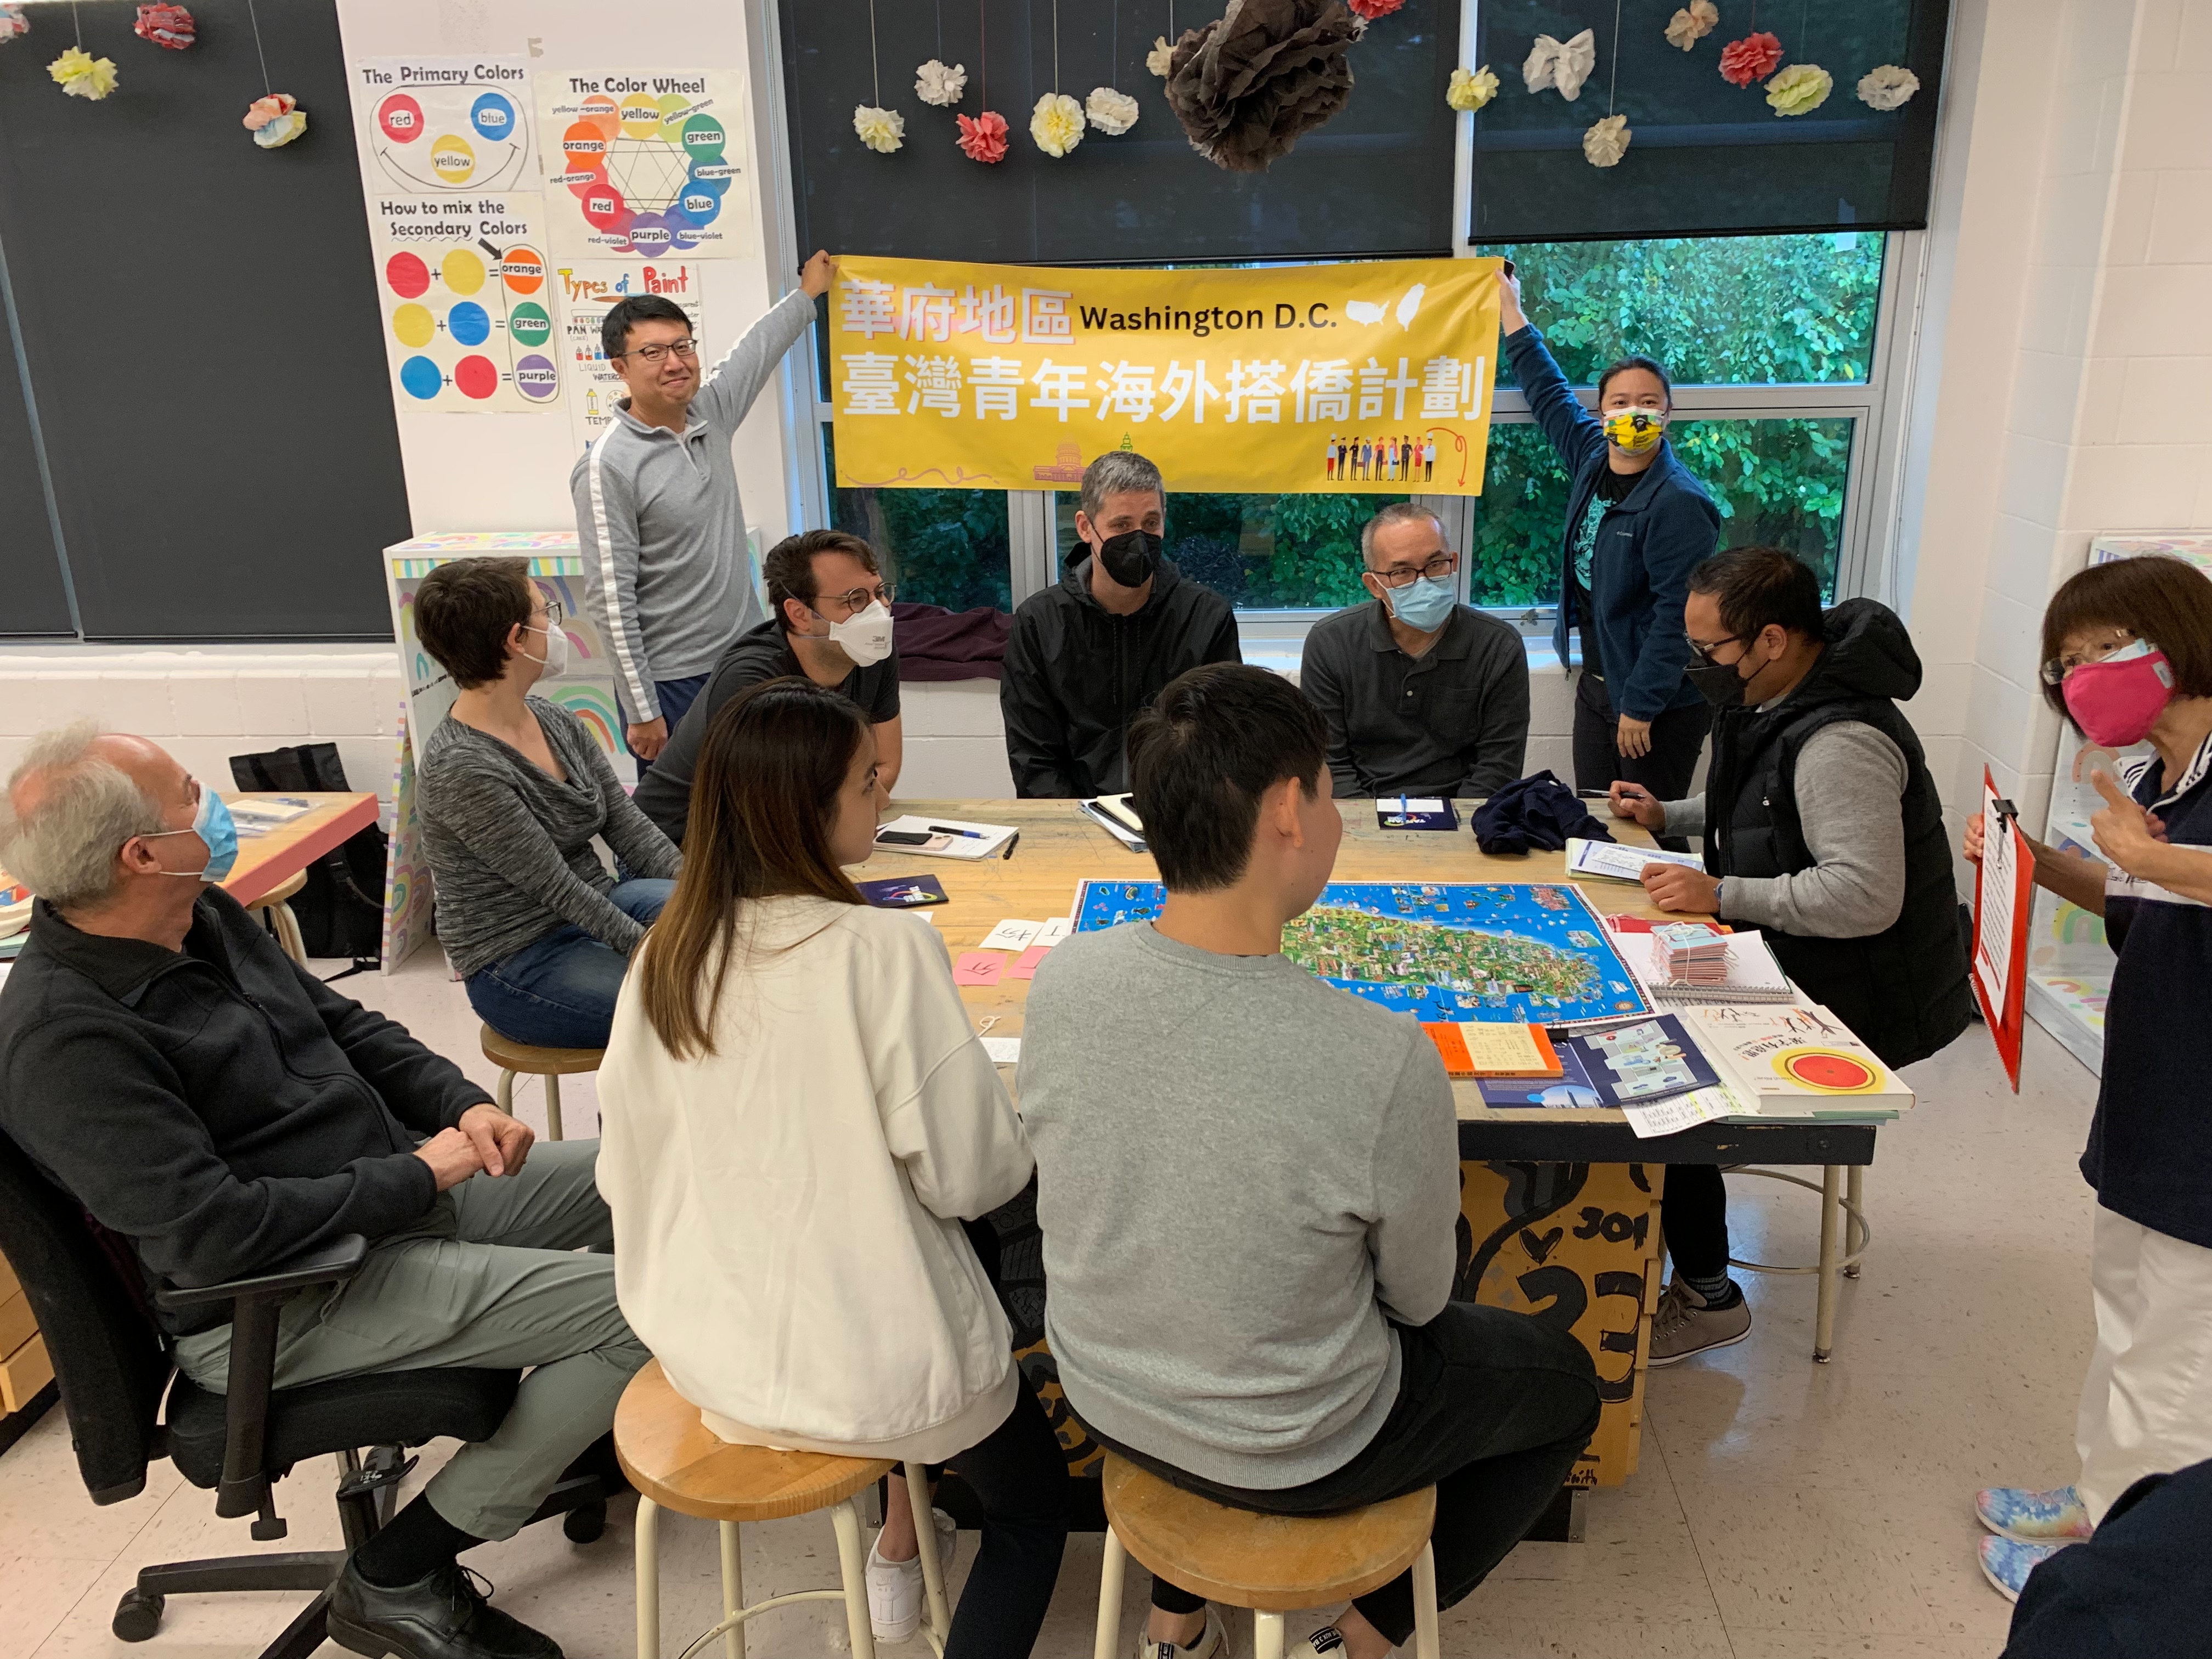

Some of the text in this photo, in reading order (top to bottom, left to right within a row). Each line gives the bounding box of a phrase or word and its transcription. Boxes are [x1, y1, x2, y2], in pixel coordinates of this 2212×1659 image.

[362, 64, 524, 84] The Primary Colors
[569, 77, 705, 93] The Color Wheel
[390, 112, 411, 126] red
[481, 113, 505, 124] blue
[621, 108, 659, 120] yellow
[687, 132, 721, 144] green
[563, 141, 604, 152] orange
[434, 155, 471, 167] yellow
[696, 167, 741, 177] blue-green
[380, 200, 505, 216] How to mix the
[592, 201, 612, 212] red
[686, 199, 713, 210] blue
[391, 221, 528, 238] Secondary Colors
[631, 229, 670, 242] purple
[502, 264, 542, 275] orange
[557, 266, 689, 302] Types of Paint
[840, 279, 1075, 345] 華府地區
[515, 319, 546, 329] green
[1079, 303, 1337, 337] Washington D.C.
[567, 325, 587, 335] PAN
[579, 363, 606, 372] LIQUID
[519, 371, 556, 382] purple
[840, 352, 1486, 424] 臺灣青年海外搭僑計劃
